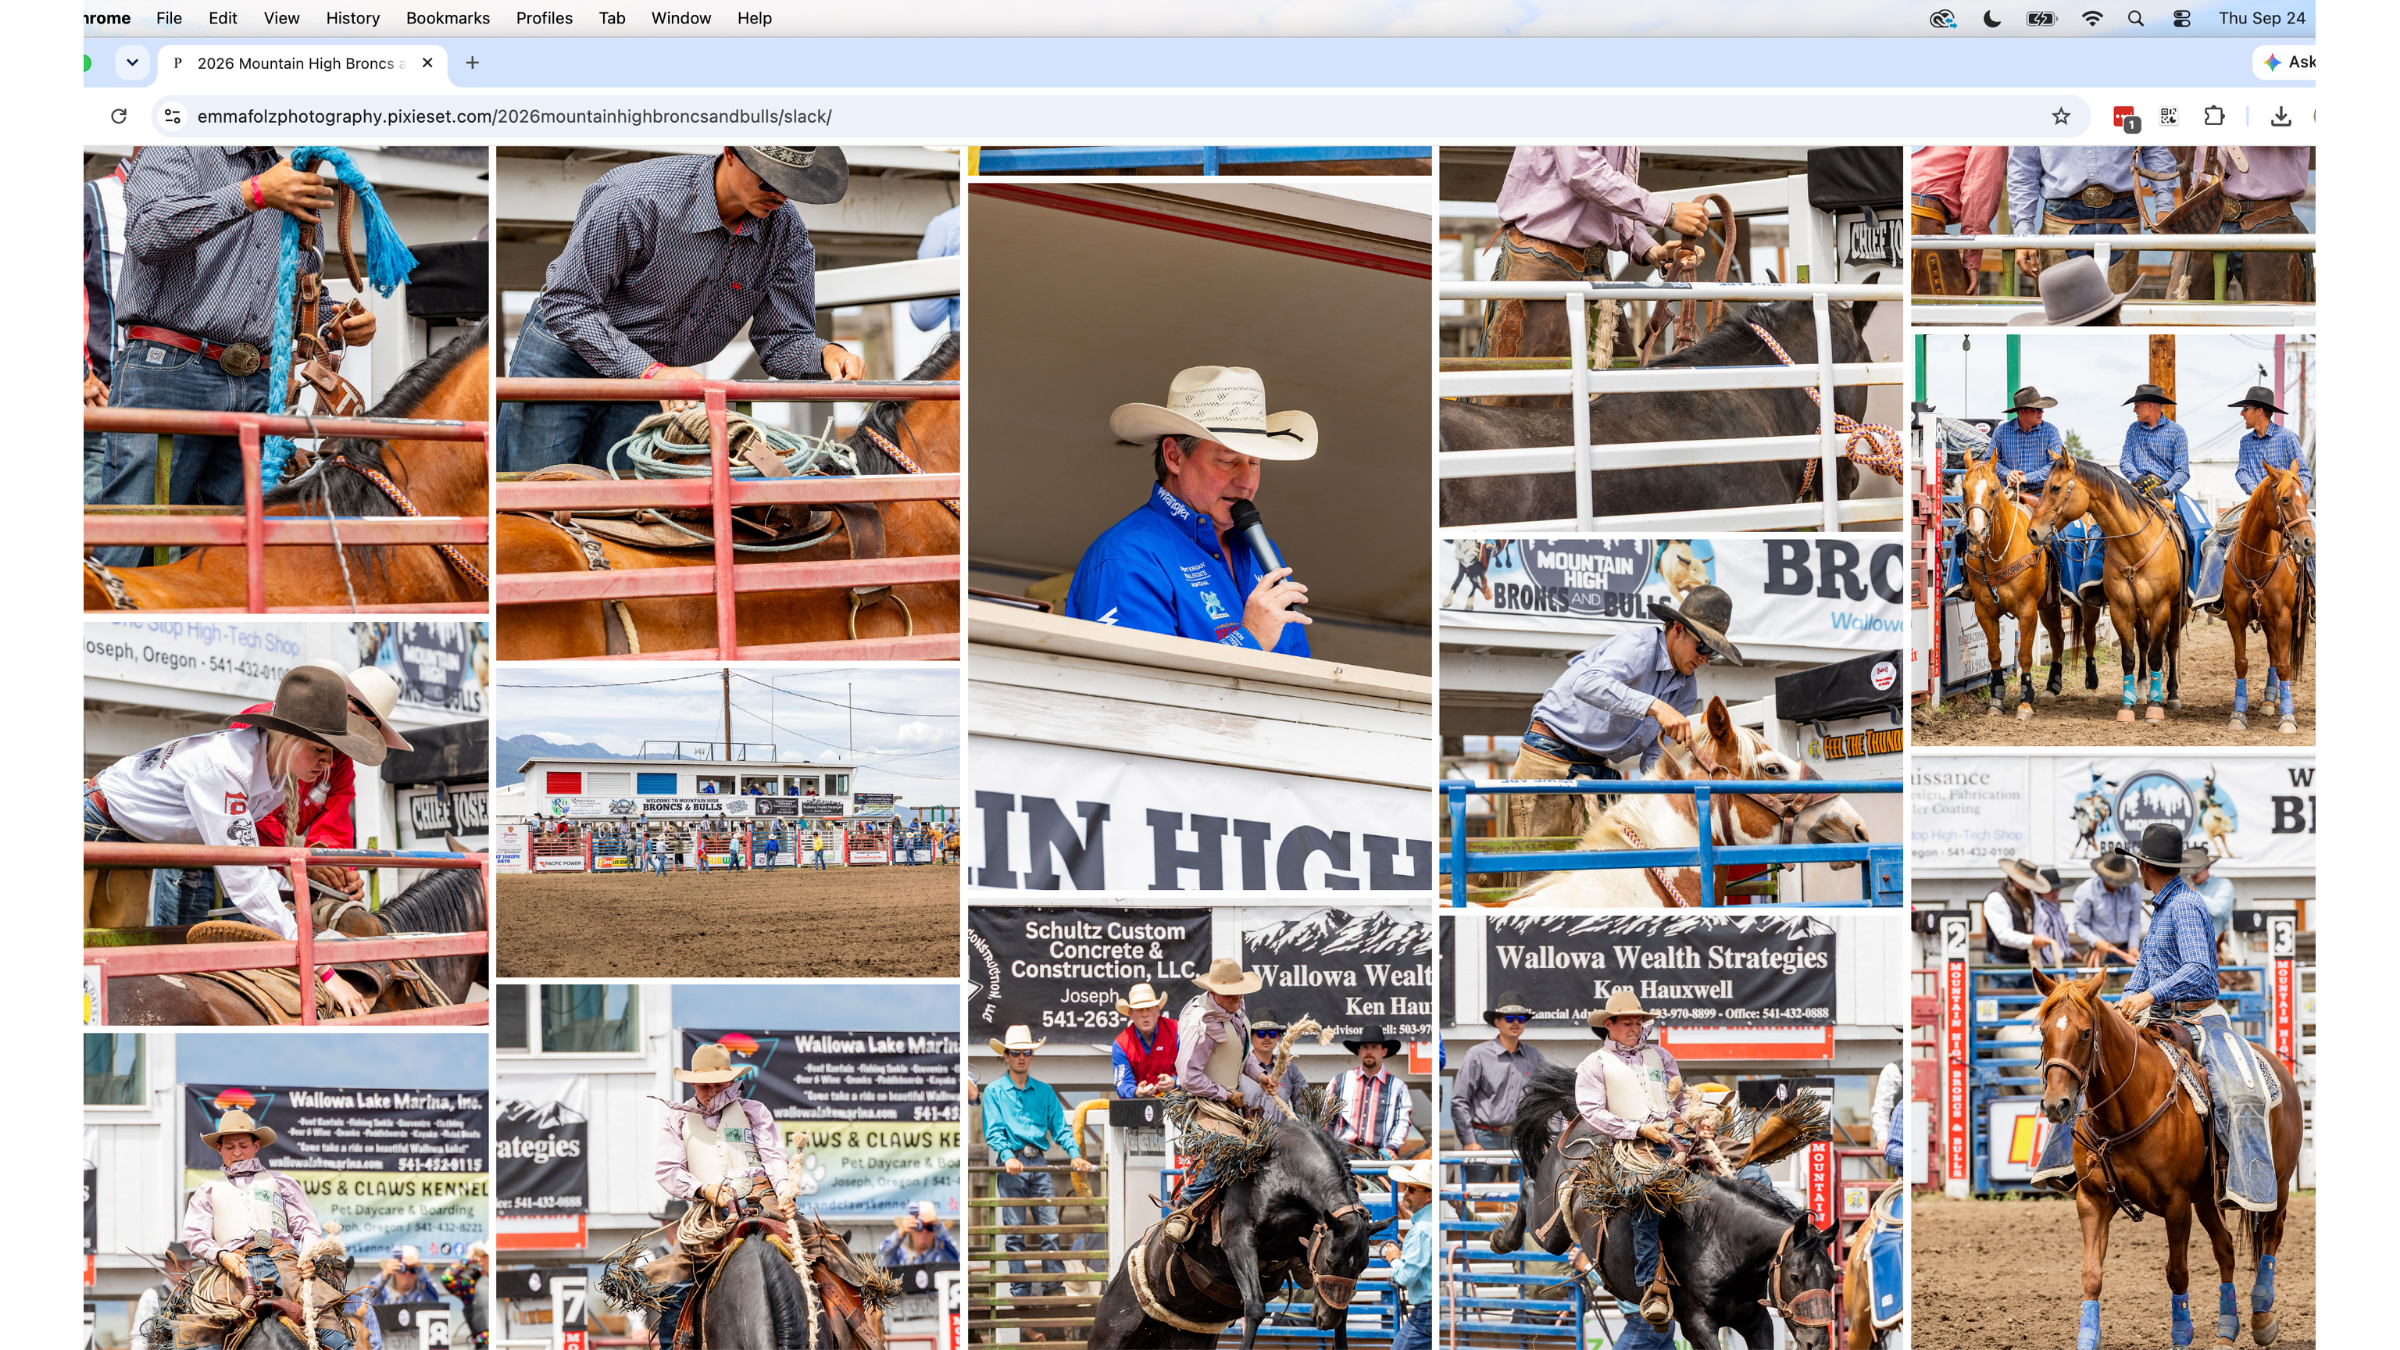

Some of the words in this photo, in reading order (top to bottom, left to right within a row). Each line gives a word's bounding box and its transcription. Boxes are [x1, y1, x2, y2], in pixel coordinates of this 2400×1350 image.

[156, 12, 182, 25] File
[209, 12, 237, 25] Edit
[264, 12, 300, 25] View
[326, 12, 381, 28] History
[406, 12, 491, 25] Bookmarks
[516, 12, 574, 25] Profiles
[599, 12, 626, 25] Tab
[651, 12, 712, 25] Window
[737, 12, 773, 28] Help
[2218, 11, 2248, 25] Thu
[2252, 11, 2282, 28] Sep
[2286, 11, 2306, 25] 24
[198, 57, 235, 71] 2026
[238, 57, 304, 71] Mountain
[308, 57, 342, 74] High
[345, 57, 395, 71] Broncs
[2289, 55, 2316, 68] Ask
[197, 109, 833, 128] emmafolzphotography.pixieset.com/2026mountainhighbroncsandbulls/slack/
[2128, 120, 2135, 131] 1
[1852, 221, 1888, 260] CHIEF
[1537, 550, 1634, 576] MOUNTAIN
[1563, 570, 1609, 591] HIGH
[1494, 583, 1569, 614] BRONCS
[1571, 592, 1601, 606] AND
[83, 637, 138, 663] oseph,
[143, 645, 197, 670] Oregon
[265, 632, 300, 659] Shop
[1823, 735, 1846, 760] FEEL
[1845, 733, 1866, 758] THE
[1950, 789, 2021, 801] Fabrication
[411, 796, 452, 831] CHIEF
[642, 803, 683, 811] BRONCS
[685, 803, 691, 811] &
[693, 803, 723, 811] BULLS
[1932, 803, 1982, 815] Coating
[1931, 829, 1991, 842] High-Tech
[1993, 829, 2024, 842] Shop
[1947, 847, 2016, 857] 541-432-0100
[1025, 921, 1103, 940] Schultz
[1107, 922, 1186, 940] Custom
[1947, 921, 1965, 954] 2
[2274, 921, 2292, 953] 3
[1049, 941, 1144, 960] Concrete
[1148, 942, 1164, 959] &
[1495, 945, 1606, 969] Wallowa
[1613, 945, 1702, 969] Wealth
[1708, 945, 1828, 975] Strategies
[1011, 959, 1152, 983] Construction,
[1157, 960, 1200, 979] LLC.
[1251, 964, 1357, 987] Wallowa
[1060, 988, 1120, 1007] Joseph
[1640, 980, 1734, 999] Hauxwell
[1950, 963, 1962, 1027] MOUNTAIN
[2277, 960, 2289, 1024] MOUNTAIN
[1345, 997, 1385, 1016] Ken
[1724, 1008, 1760, 1019] Office:
[1762, 1008, 1830, 1019] 541-432-0888
[794, 1035, 866, 1054] Wallowa
[867, 1036, 906, 1054] Lake
[288, 1091, 355, 1110] Wallowa
[356, 1092, 392, 1110] Lake
[393, 1093, 456, 1112] Marina,
[457, 1093, 484, 1111] Inc.
[830, 1090, 850, 1101] take
[888, 1090, 925, 1102] beautiful
[1952, 1070, 1963, 1118] BRONCS
[773, 1105, 898, 1120] wallowalakemarina.com
[321, 1143, 340, 1153] take
[375, 1143, 409, 1154] beautiful
[409, 1143, 444, 1154] Wallowa
[785, 1131, 842, 1149] PWS
[848, 1132, 860, 1148] &
[866, 1131, 932, 1149] CLAWS
[268, 1156, 384, 1170] wallowalakemarina.com
[841, 1157, 864, 1169] Pet
[867, 1157, 921, 1172] Daycare
[1952, 1137, 1963, 1178] BULLS
[337, 1181, 349, 1196] &
[354, 1181, 416, 1196] CLAWS
[422, 1181, 489, 1197] KENNEL
[830, 1177, 874, 1189] Joseph,
[876, 1177, 920, 1190] Oregon
[1811, 1143, 1826, 1222] MOUNTAIN
[331, 1204, 351, 1216] Pet
[355, 1204, 406, 1218] Daycare
[420, 1205, 475, 1218] Boarding
[563, 1289, 585, 1323] 7
